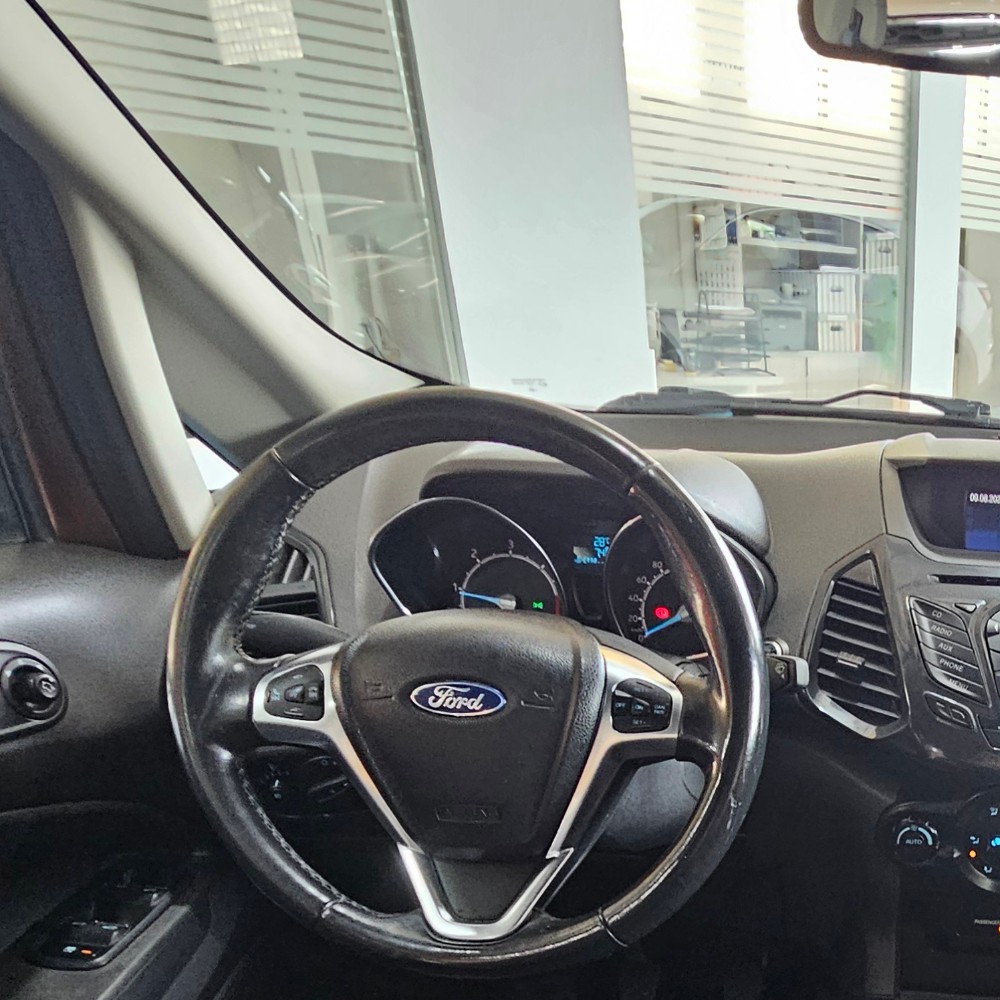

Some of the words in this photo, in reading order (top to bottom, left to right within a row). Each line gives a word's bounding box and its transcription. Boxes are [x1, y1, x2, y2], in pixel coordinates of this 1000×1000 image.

[508, 539, 514, 549] 3
[470, 548, 477, 559] 2
[652, 561, 663, 569] 80
[636, 576, 647, 584] 60
[452, 582, 458, 592] 1
[628, 594, 639, 602] 40
[628, 614, 639, 622] 20
[931, 610, 943, 619] CD
[931, 624, 953, 637] RADIO
[938, 642, 953, 652] AUX
[939, 658, 964, 672] PHONE
[428, 685, 485, 711] Ford
